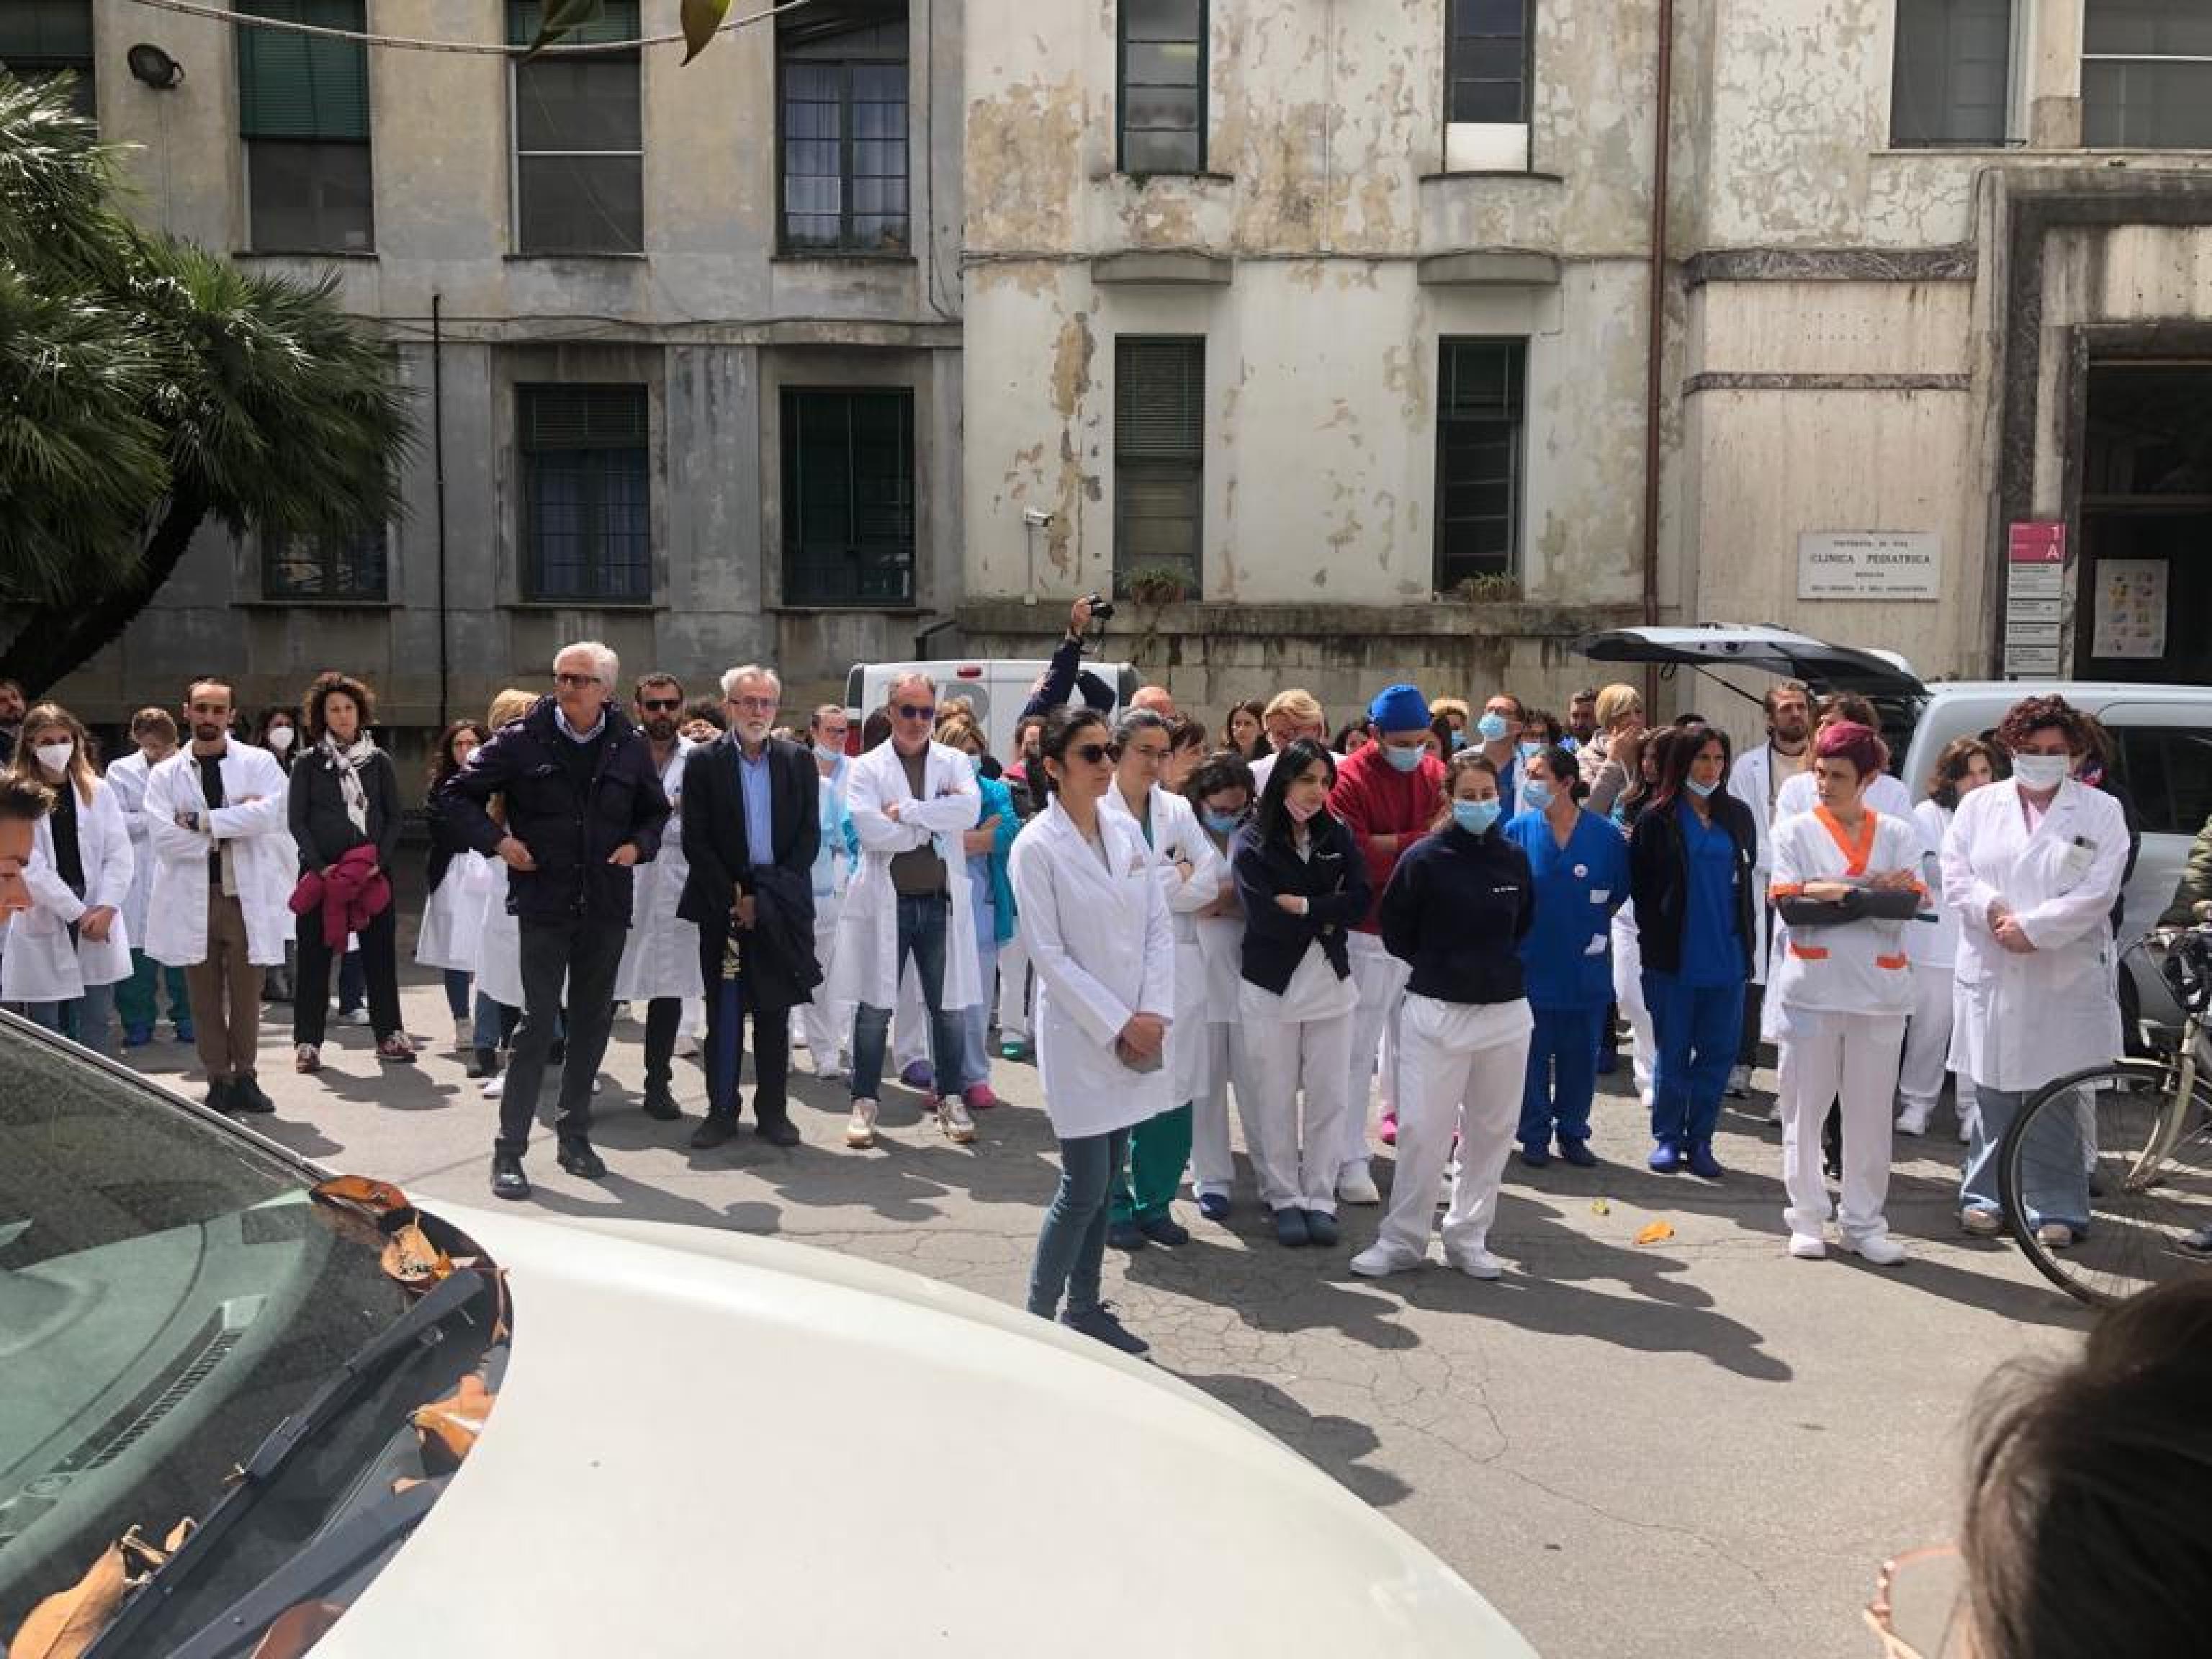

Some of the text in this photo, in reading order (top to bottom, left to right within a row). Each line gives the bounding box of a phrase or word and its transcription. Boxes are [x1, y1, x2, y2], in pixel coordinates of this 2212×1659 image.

[2045, 543, 2059, 559] A
[1810, 554, 1930, 564] CLINICA PEDIATRICA
